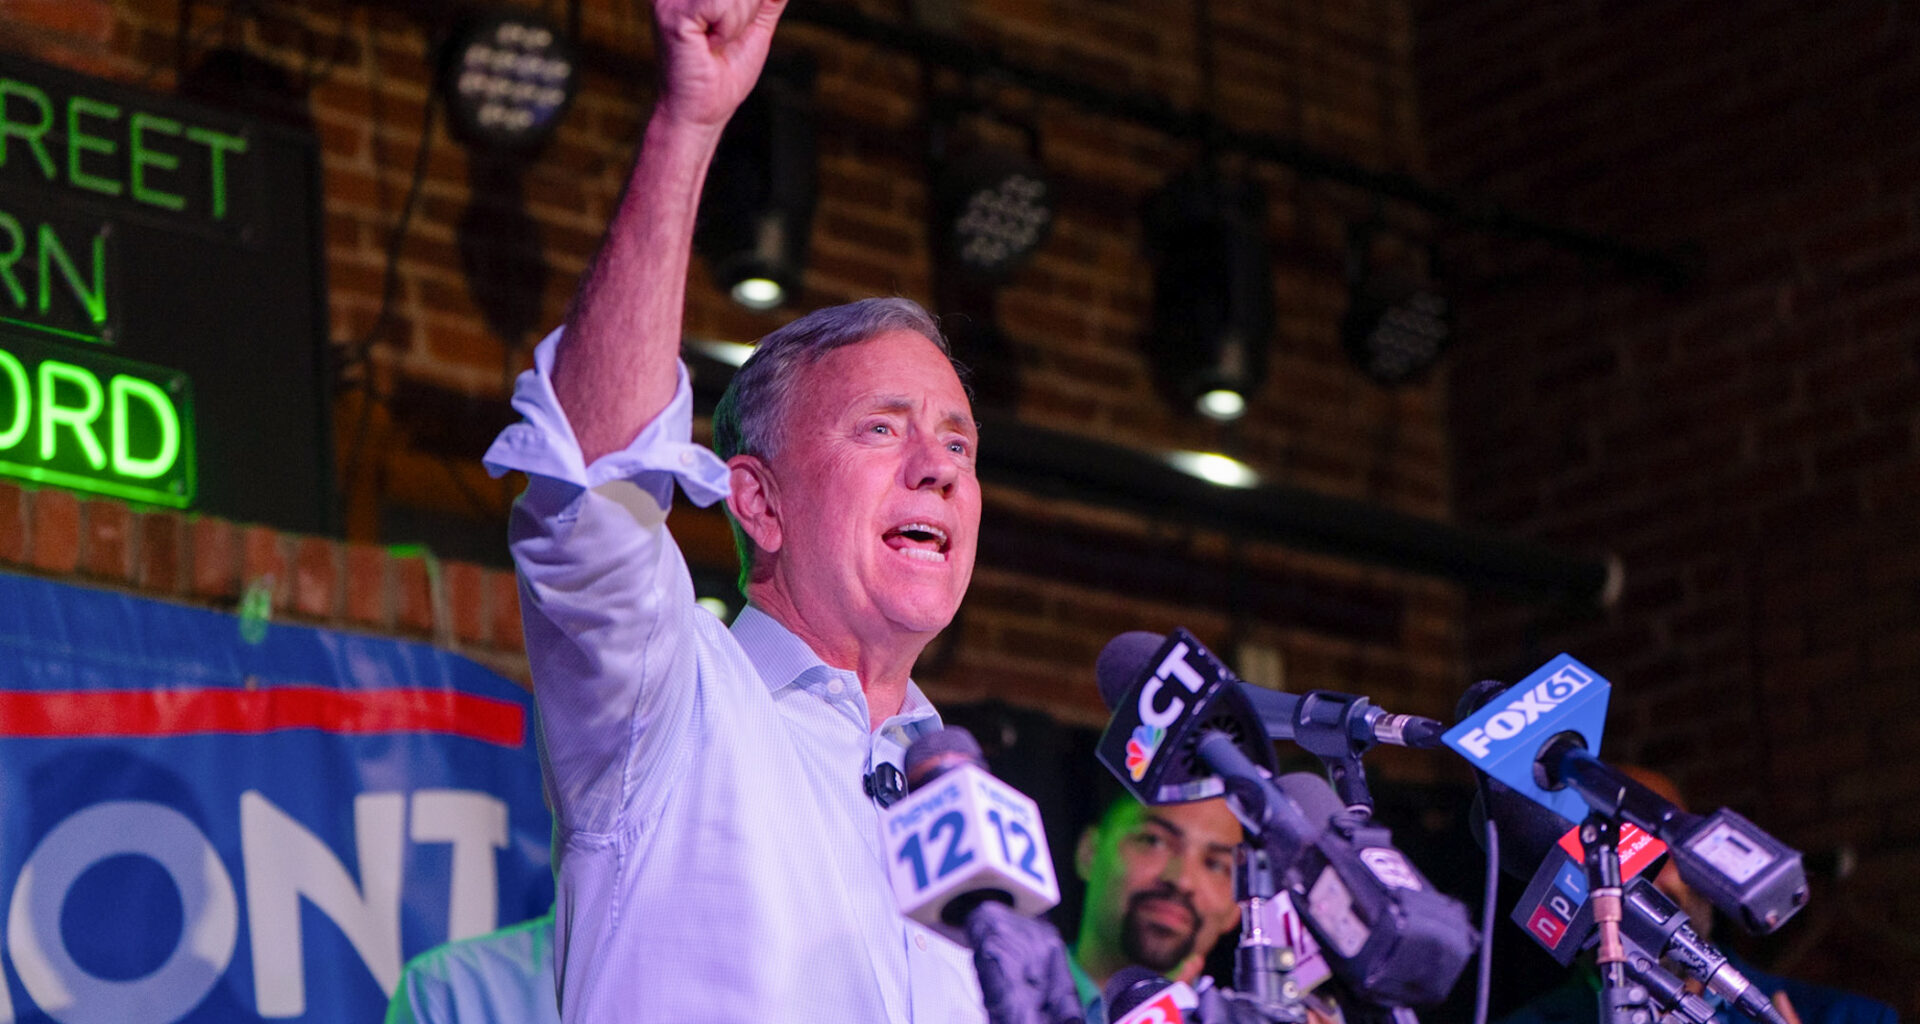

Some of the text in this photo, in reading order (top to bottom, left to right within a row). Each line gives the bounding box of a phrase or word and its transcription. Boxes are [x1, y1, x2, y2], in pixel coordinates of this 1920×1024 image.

[0, 78, 248, 219] REET
[1138, 641, 1205, 729] CT
[898, 810, 974, 891] 12
[988, 809, 1045, 884] 12
[0, 789, 510, 1024] ONT
[1537, 873, 1580, 938] npr
